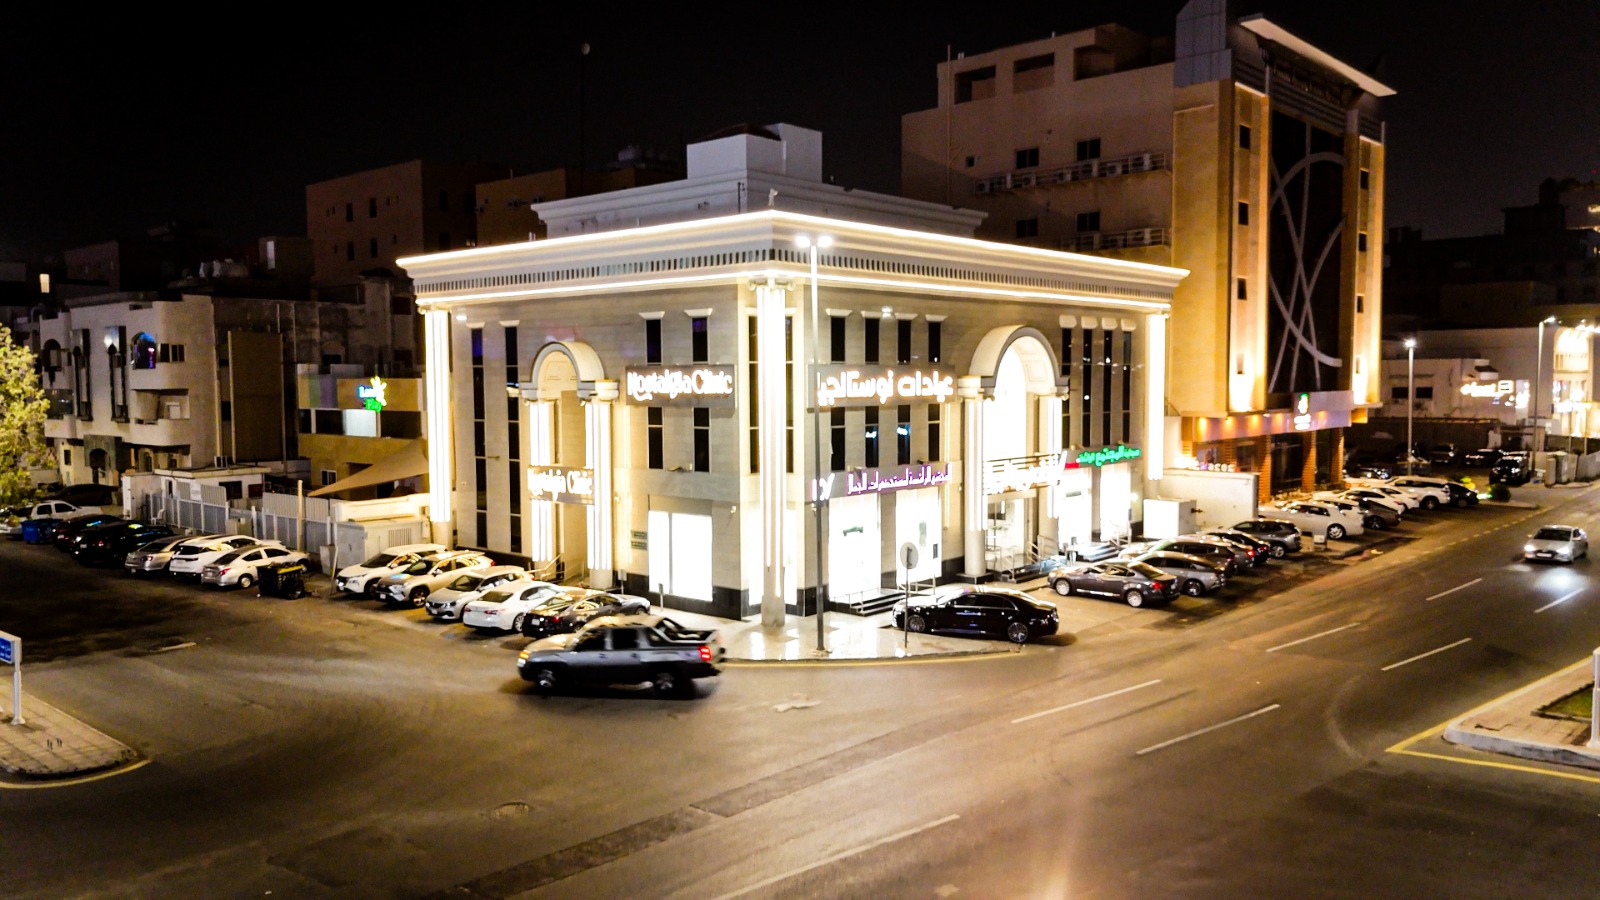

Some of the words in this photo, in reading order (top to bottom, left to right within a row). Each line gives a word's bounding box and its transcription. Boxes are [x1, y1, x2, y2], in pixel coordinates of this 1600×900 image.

[627, 369, 692, 401] Nostalgia
[692, 369, 733, 395] Clinic
[898, 370, 954, 403] عيادات
